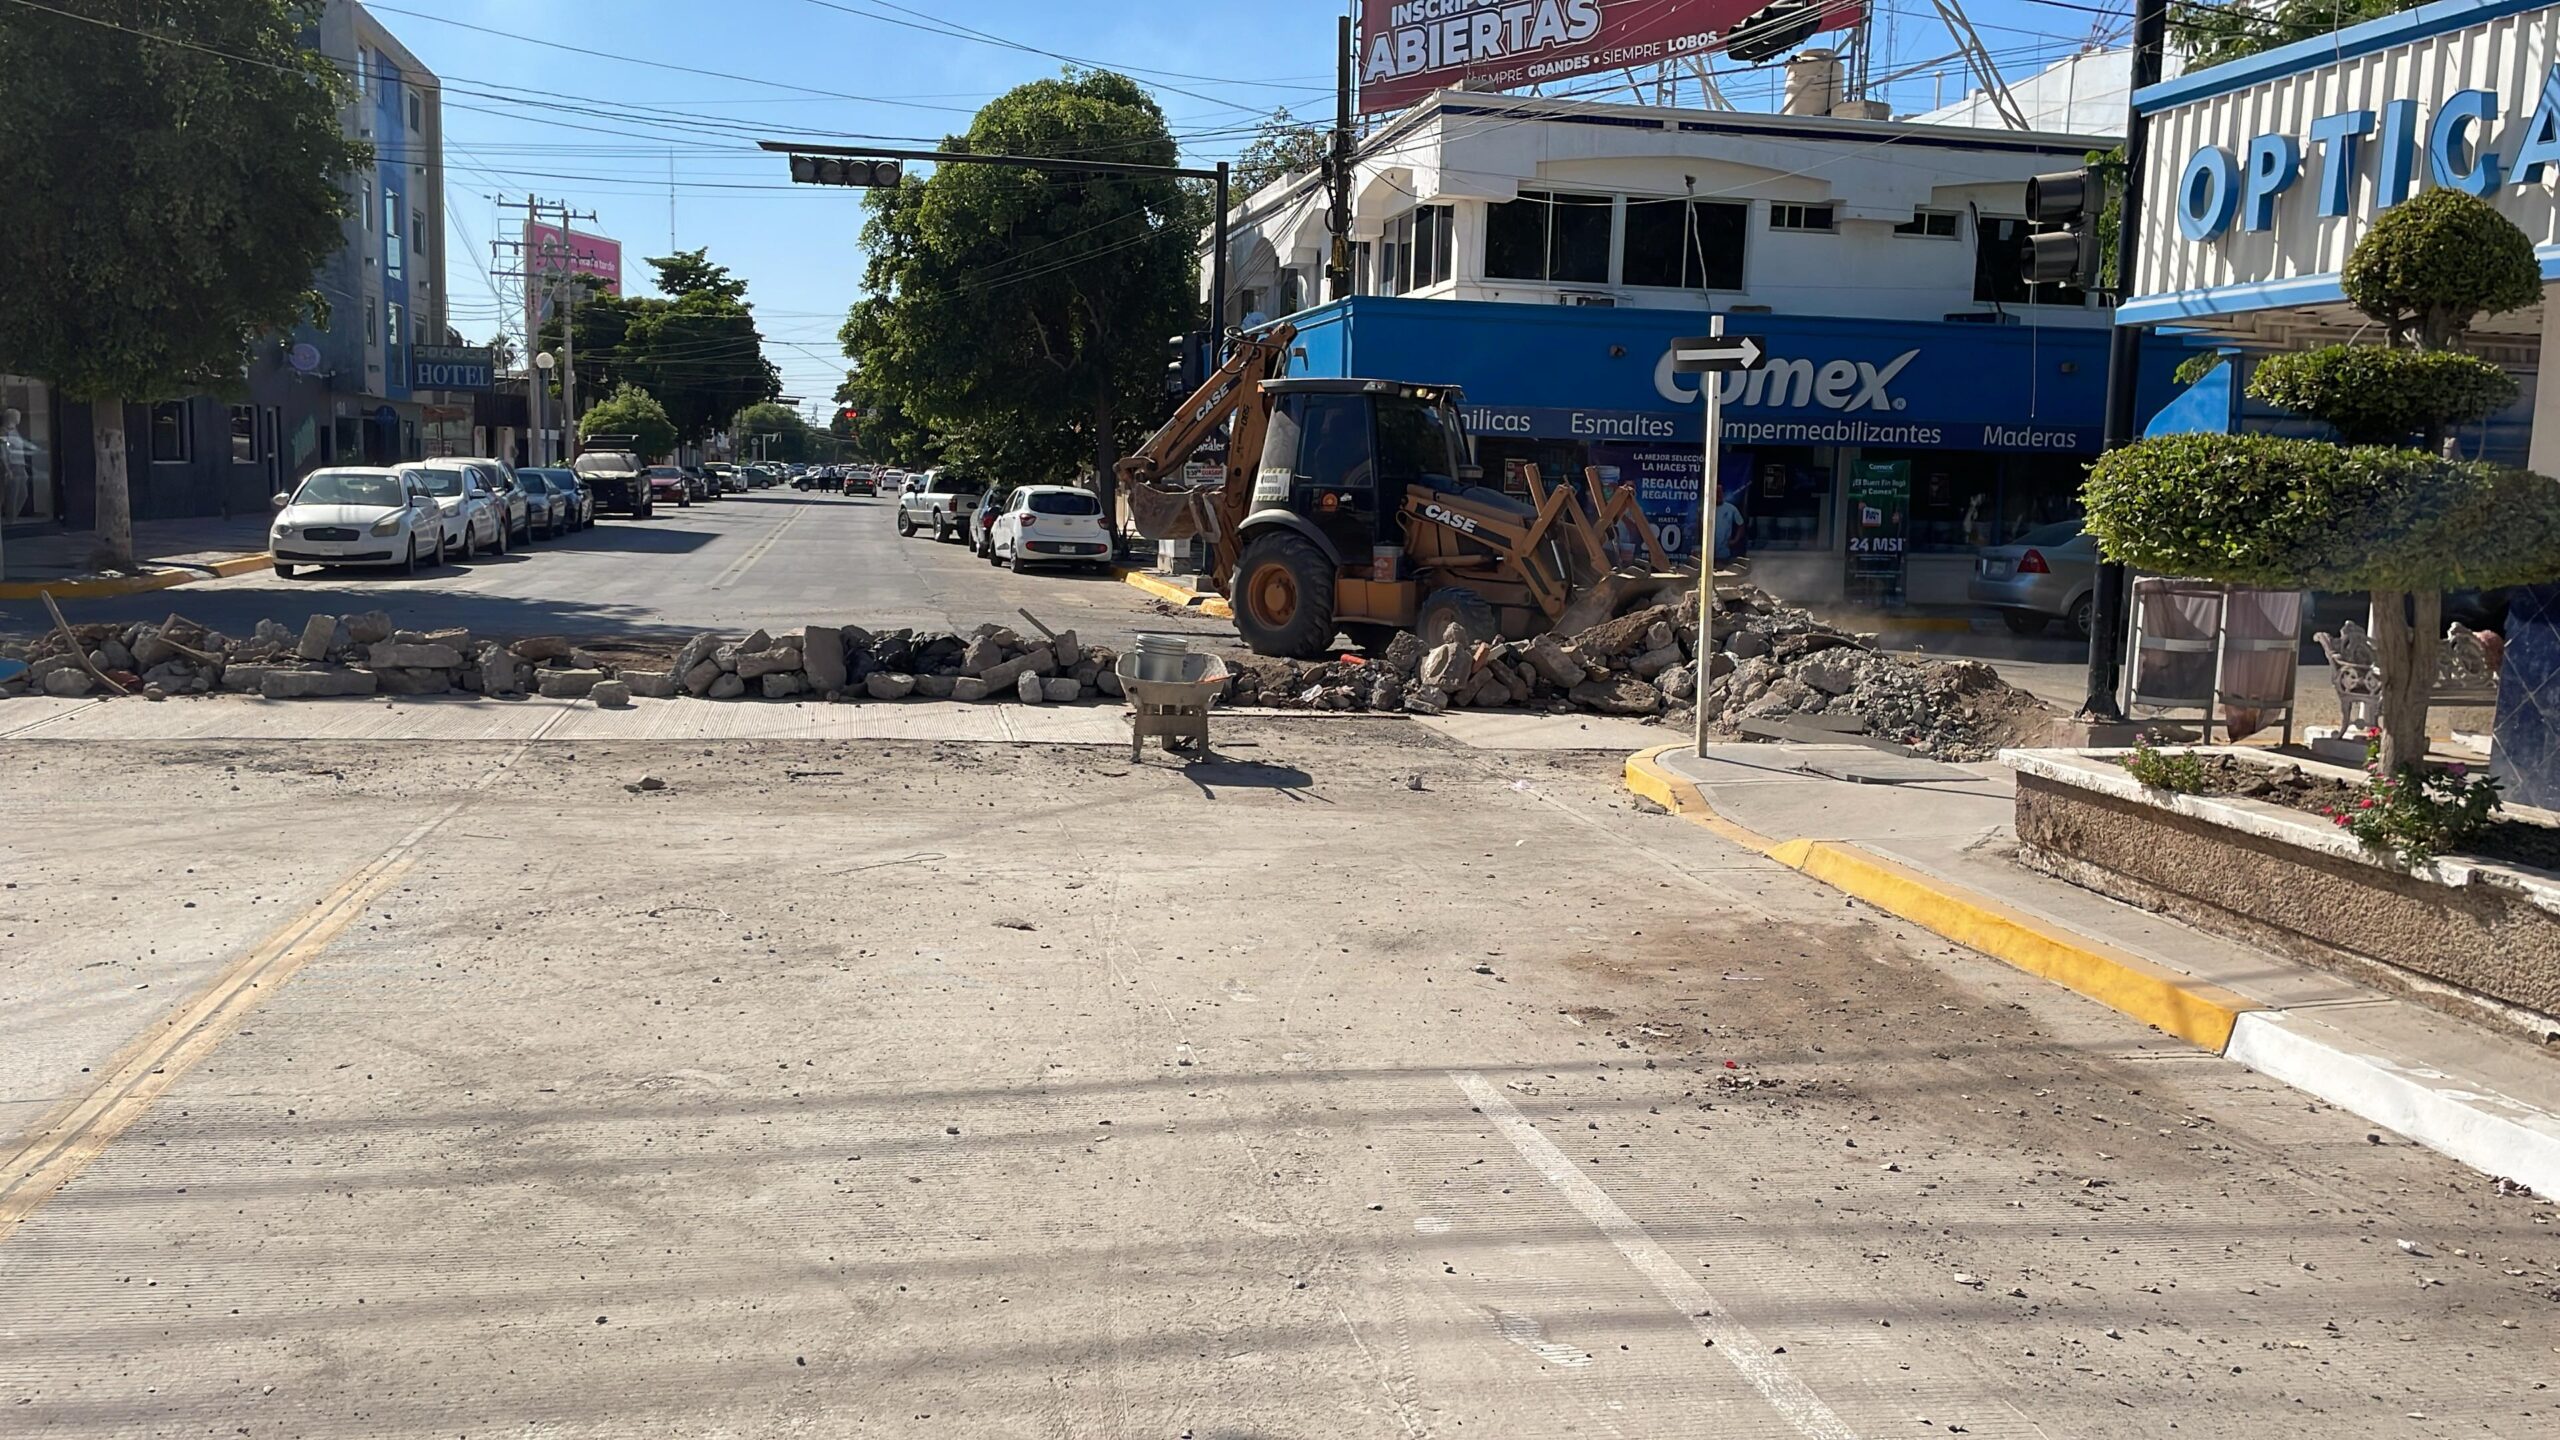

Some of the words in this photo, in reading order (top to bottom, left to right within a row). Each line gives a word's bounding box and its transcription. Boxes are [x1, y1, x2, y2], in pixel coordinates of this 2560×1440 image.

[1391, 0, 1500, 27] INSCRIP
[1361, 0, 1600, 83] ABIERTAS
[1528, 54, 1590, 78] GRANDES
[1602, 42, 1661, 65] SIEMPRE
[1668, 31, 1717, 52] LOBOS
[416, 363, 490, 386] HOTEL
[1196, 382, 1229, 421] CASE
[1460, 408, 1531, 432] nilicas
[1571, 412, 1674, 437] Esmaltes
[1718, 418, 1942, 443] Impermeabilizantes
[1983, 425, 2076, 448] Maderas
[1642, 462, 1654, 471] LA
[1656, 463, 1687, 472] HACES
[1645, 453, 1670, 462] MEJOR
[1671, 454, 1705, 463] SELECCIÓ
[1642, 476, 1699, 490] REGALÓN
[1642, 490, 1698, 501] REGALITRO
[1425, 504, 1478, 533] CASE
[1850, 538, 1869, 552] 24
